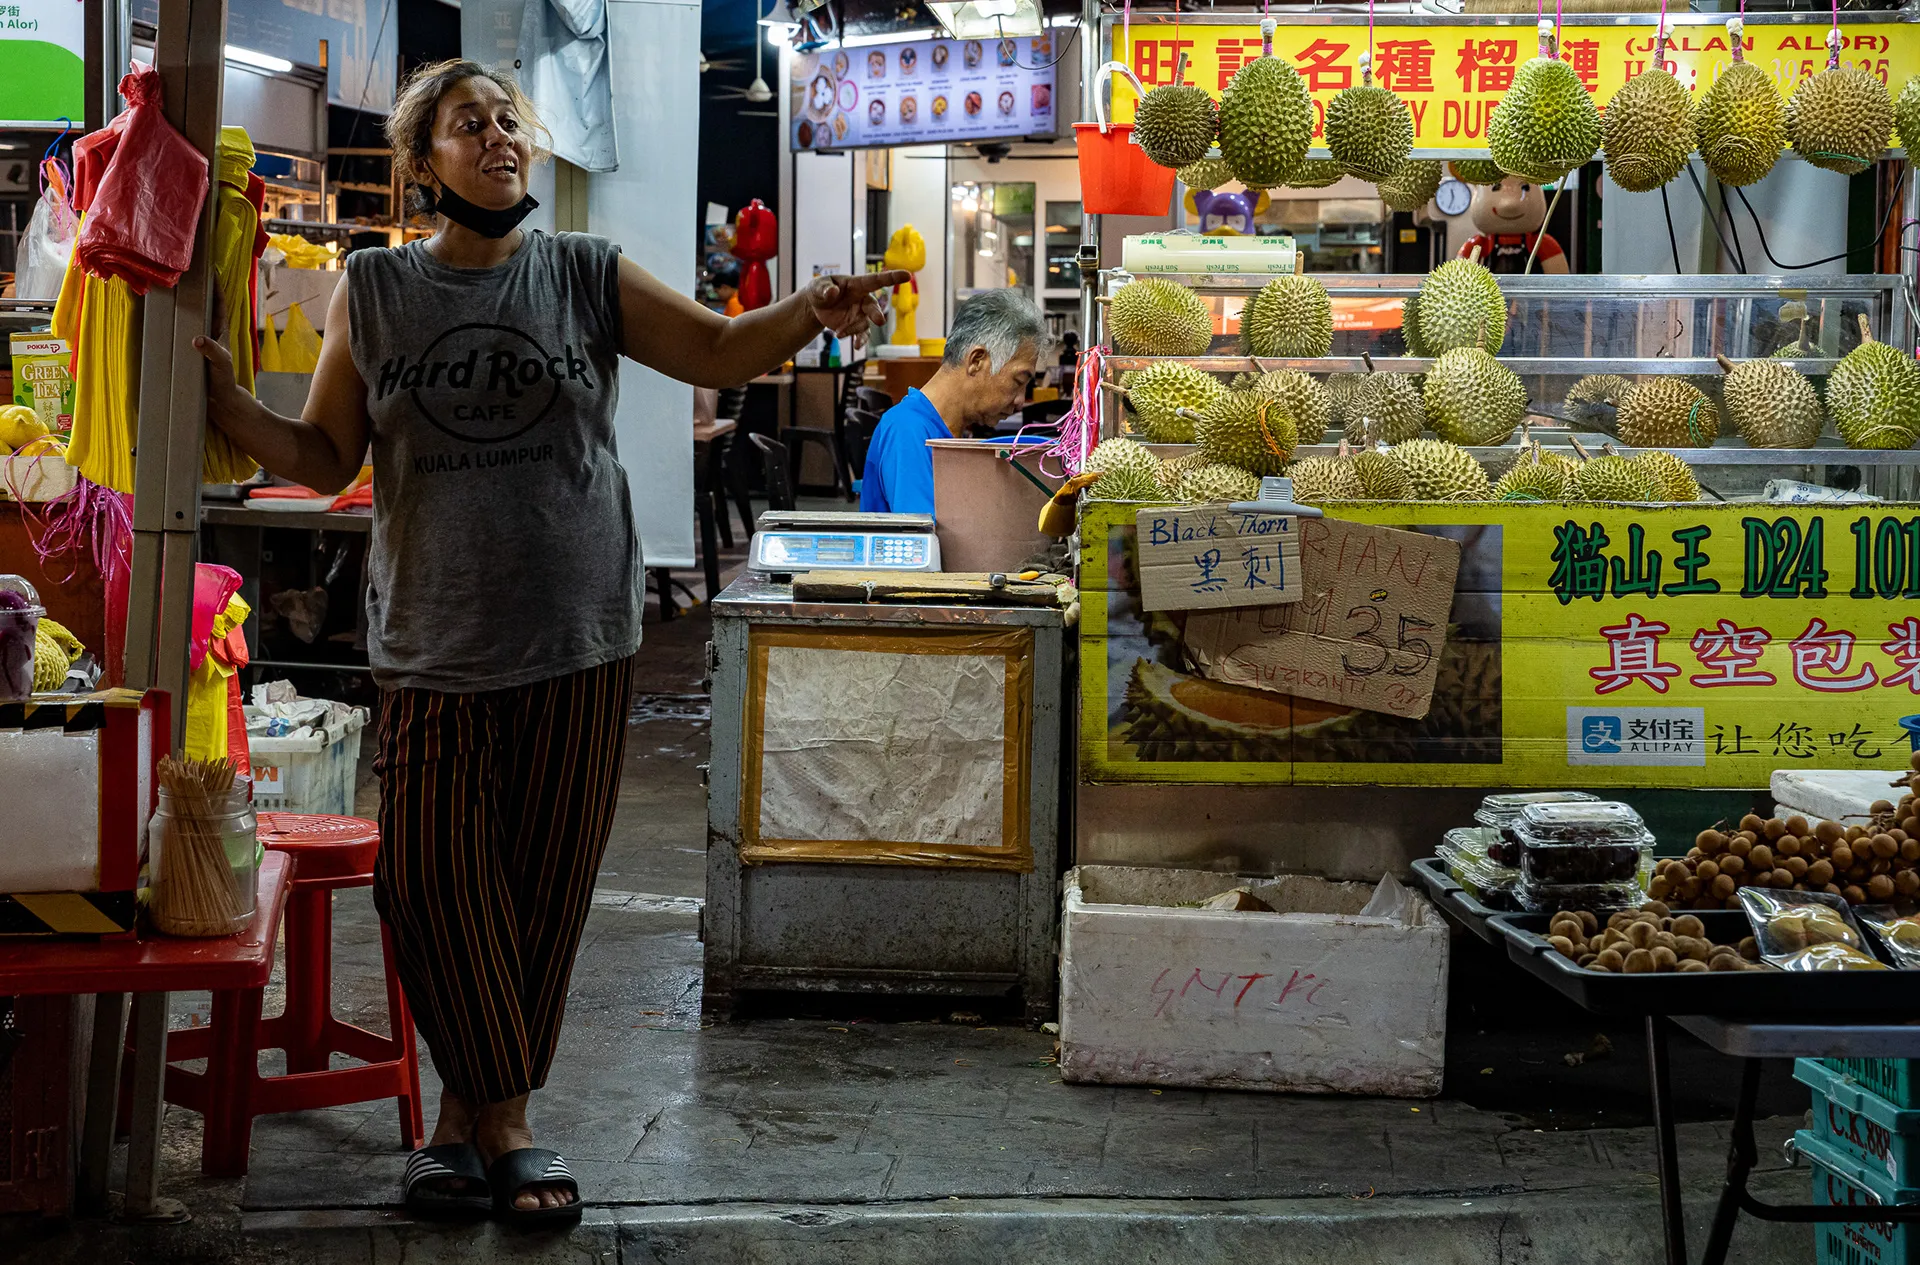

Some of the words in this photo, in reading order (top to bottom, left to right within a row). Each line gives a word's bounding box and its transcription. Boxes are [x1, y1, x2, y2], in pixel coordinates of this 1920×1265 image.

[7, 19, 38, 31] Alor)
[21, 364, 69, 381] GREEN
[378, 350, 478, 401] Hard
[486, 345, 595, 398] Rock
[33, 382, 60, 398] TEA
[453, 404, 517, 422] CAFE
[413, 453, 472, 475] KUALA
[475, 444, 554, 469] LUMPUR
[1150, 516, 1219, 547] Black
[1232, 511, 1289, 535] Thorn
[1548, 519, 1721, 606] 猫山王
[1740, 516, 1829, 599] D24
[1341, 605, 1436, 677] 35
[1627, 718, 1694, 741] 支付宝
[1708, 724, 1912, 759] 让您吃
[1630, 742, 1693, 752] ALIPAY
